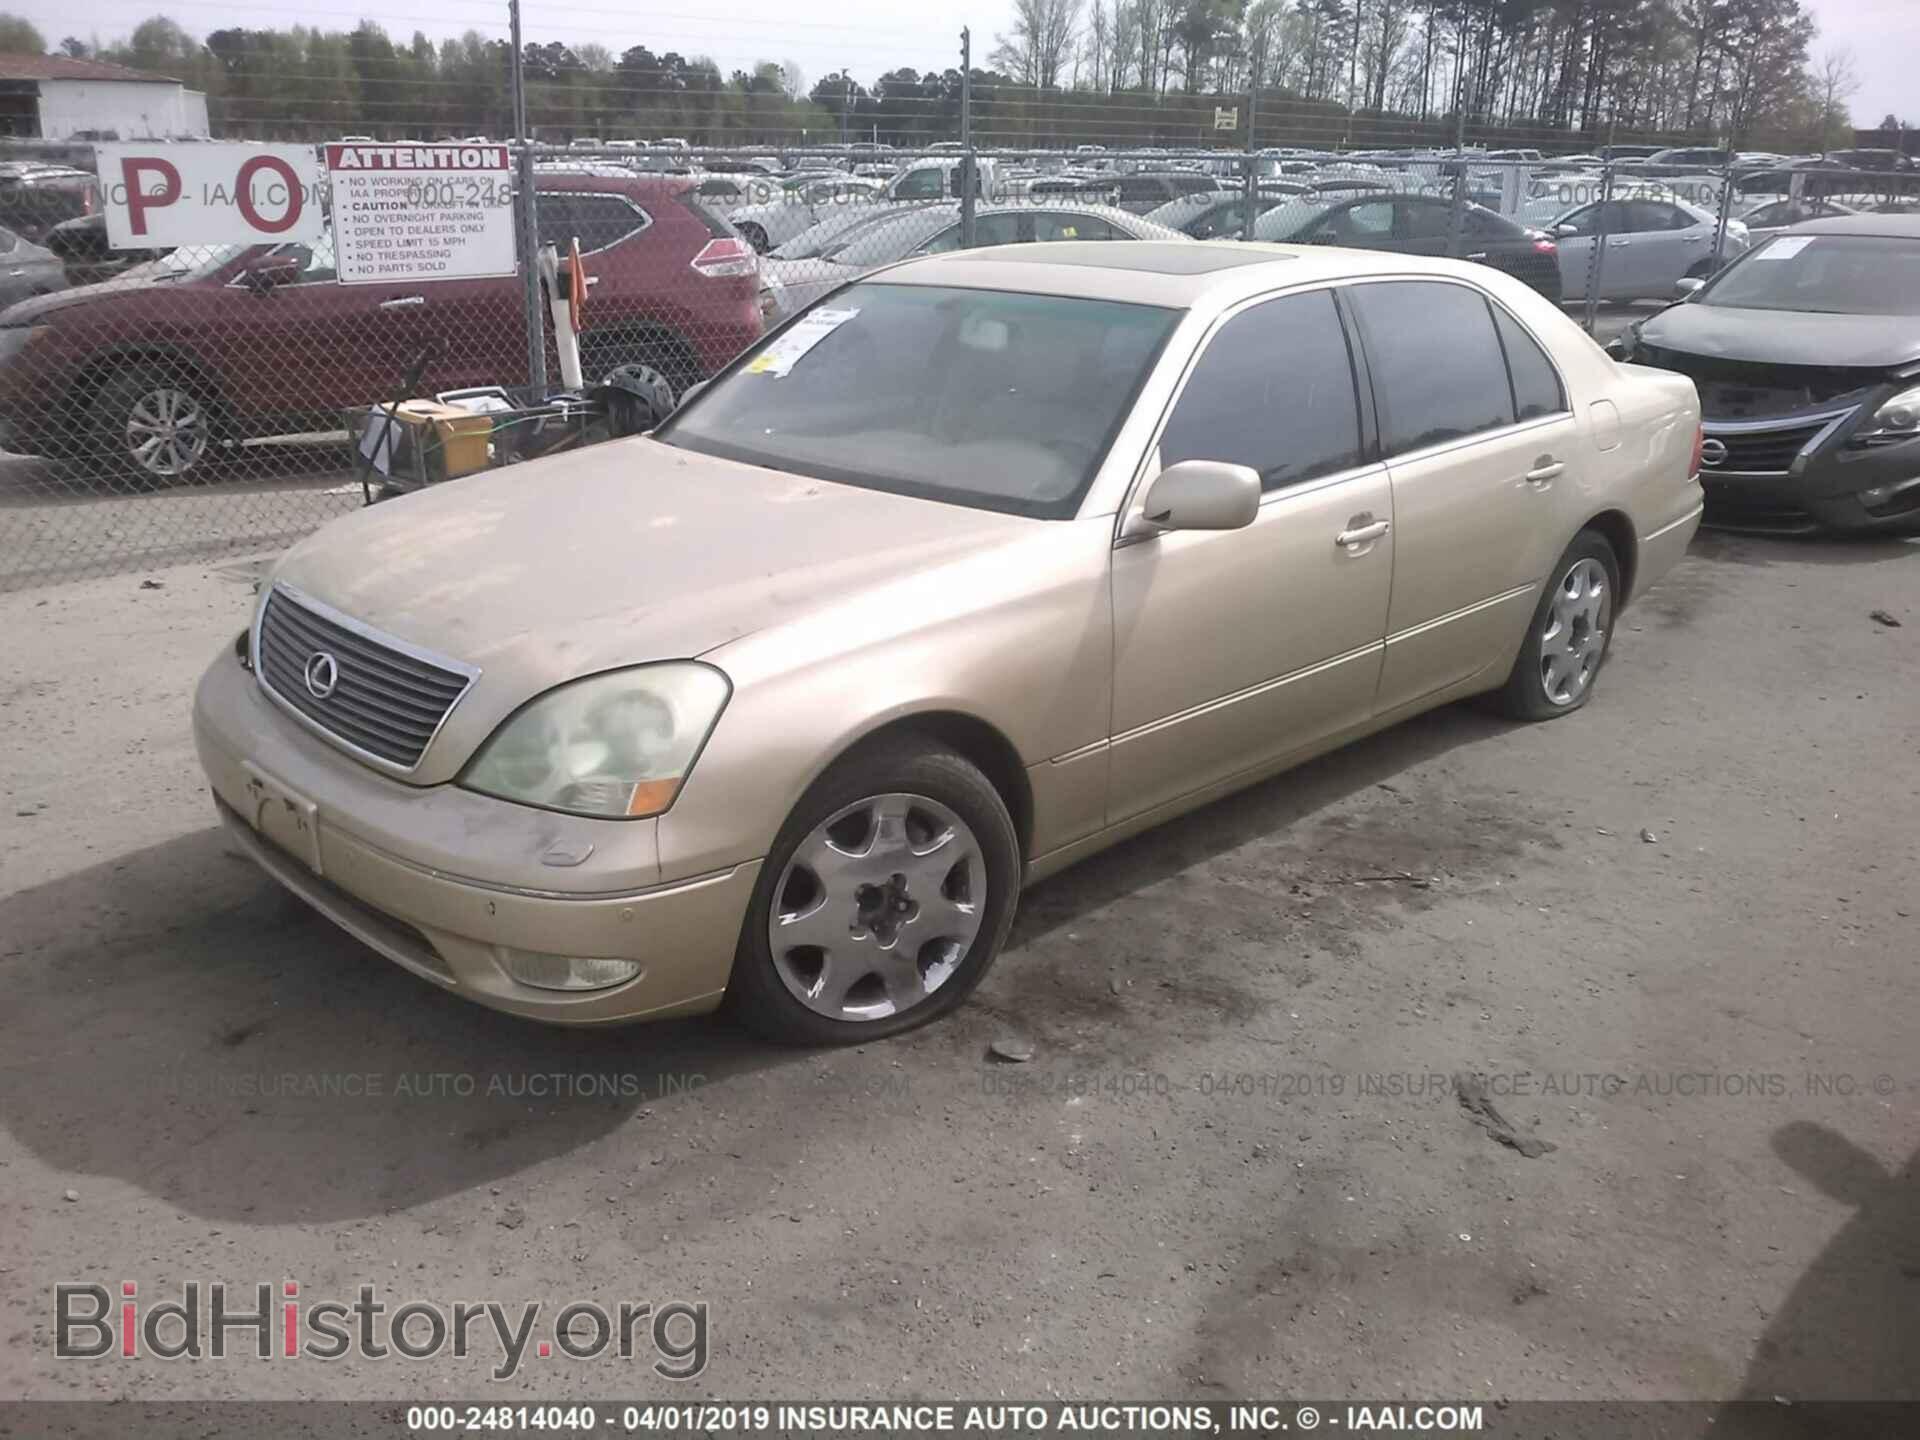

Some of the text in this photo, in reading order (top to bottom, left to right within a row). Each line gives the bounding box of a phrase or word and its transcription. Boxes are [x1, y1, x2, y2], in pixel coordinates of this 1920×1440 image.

[338, 148, 501, 168] ATTENTION
[350, 176, 494, 186] NO WORKING ON CARS ON
[120, 155, 304, 235] P O
[350, 189, 369, 198] IAA
[352, 202, 408, 211] CAUTION
[353, 212, 484, 224] NO OVERNIGHT PARKING
[354, 225, 485, 236] OPEN TO DEALERS ONLY
[355, 238, 466, 249] SPEED LIMIT 15 MPH
[357, 250, 451, 262] NO TRESPASSING
[358, 262, 446, 274] NO PARTS SOLD
